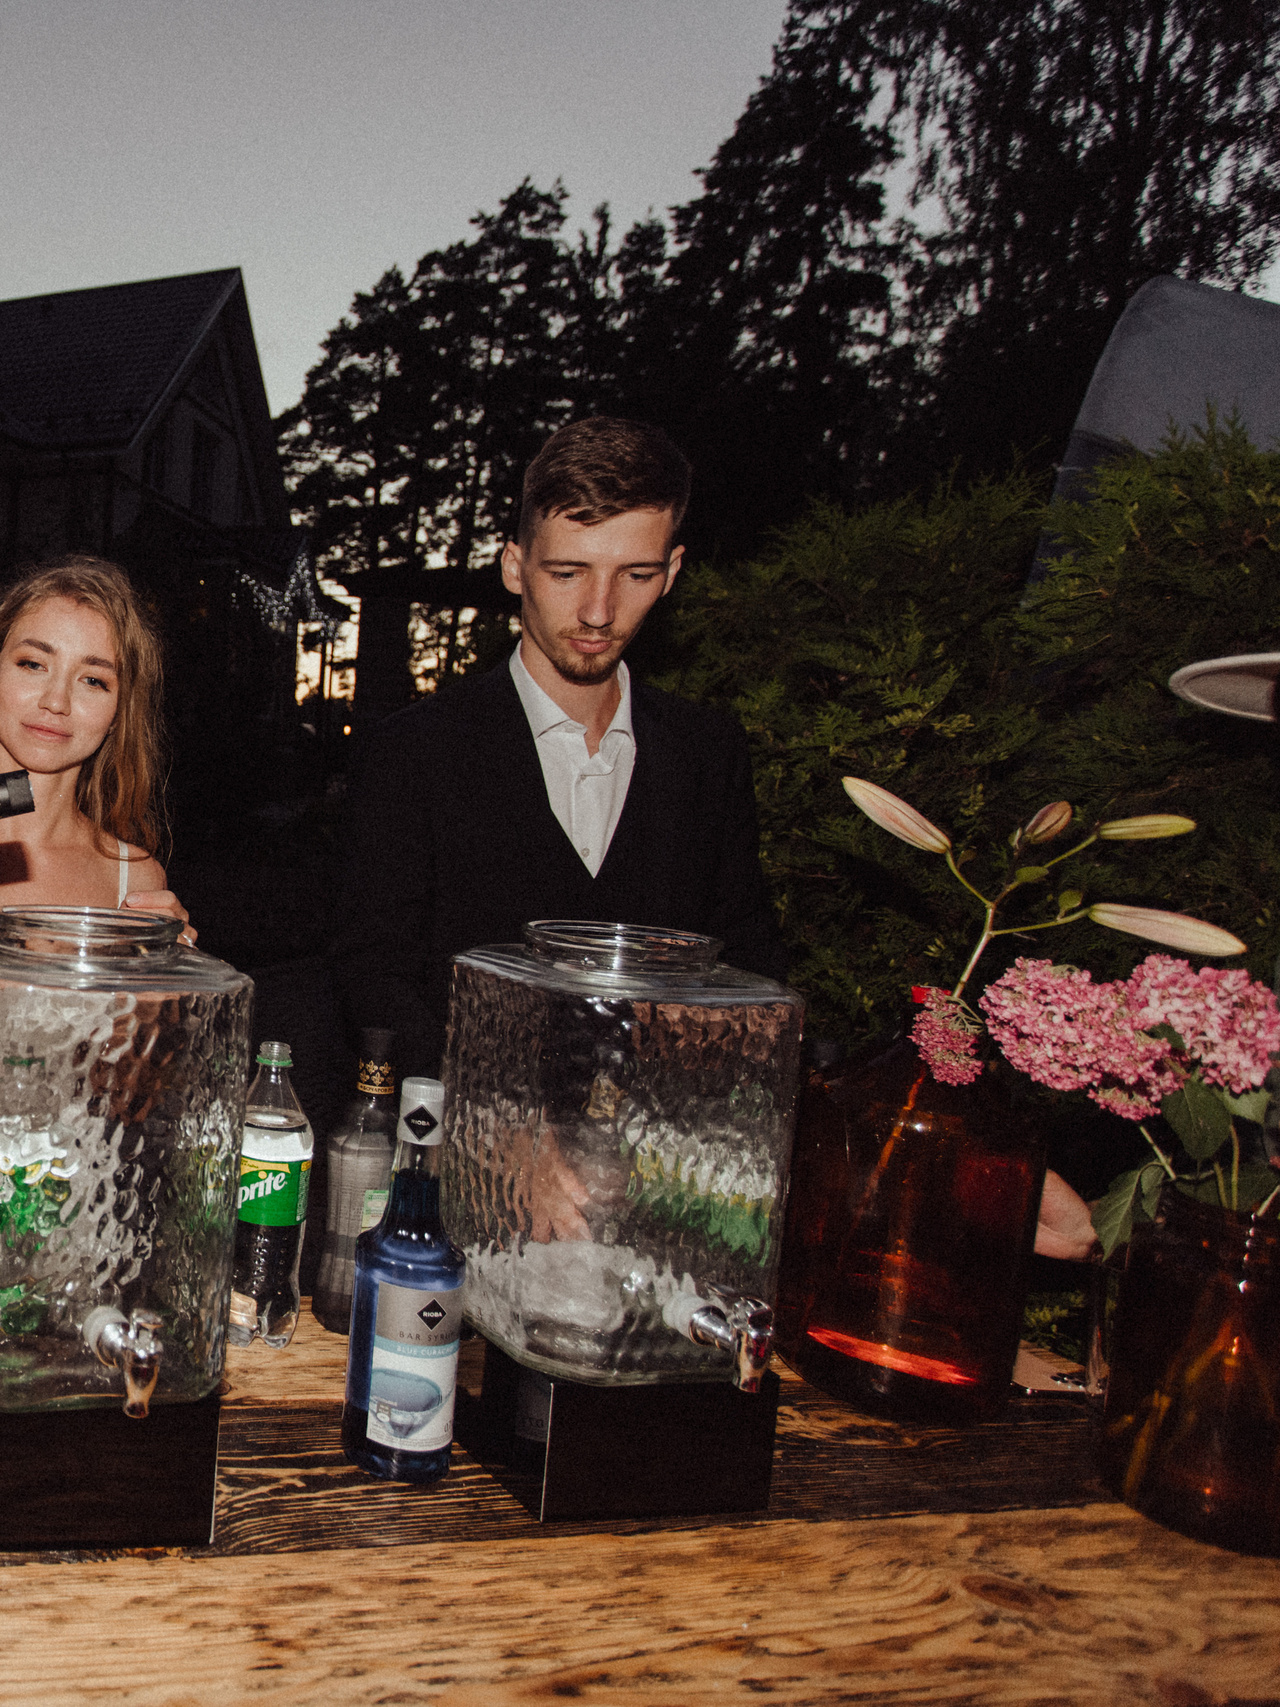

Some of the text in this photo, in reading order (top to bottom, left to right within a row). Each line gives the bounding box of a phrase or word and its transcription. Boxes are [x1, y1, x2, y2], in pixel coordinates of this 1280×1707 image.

[410, 1118, 431, 1127] RIOBA
[237, 1170, 286, 1210] prite
[399, 1331, 421, 1341] BAR
